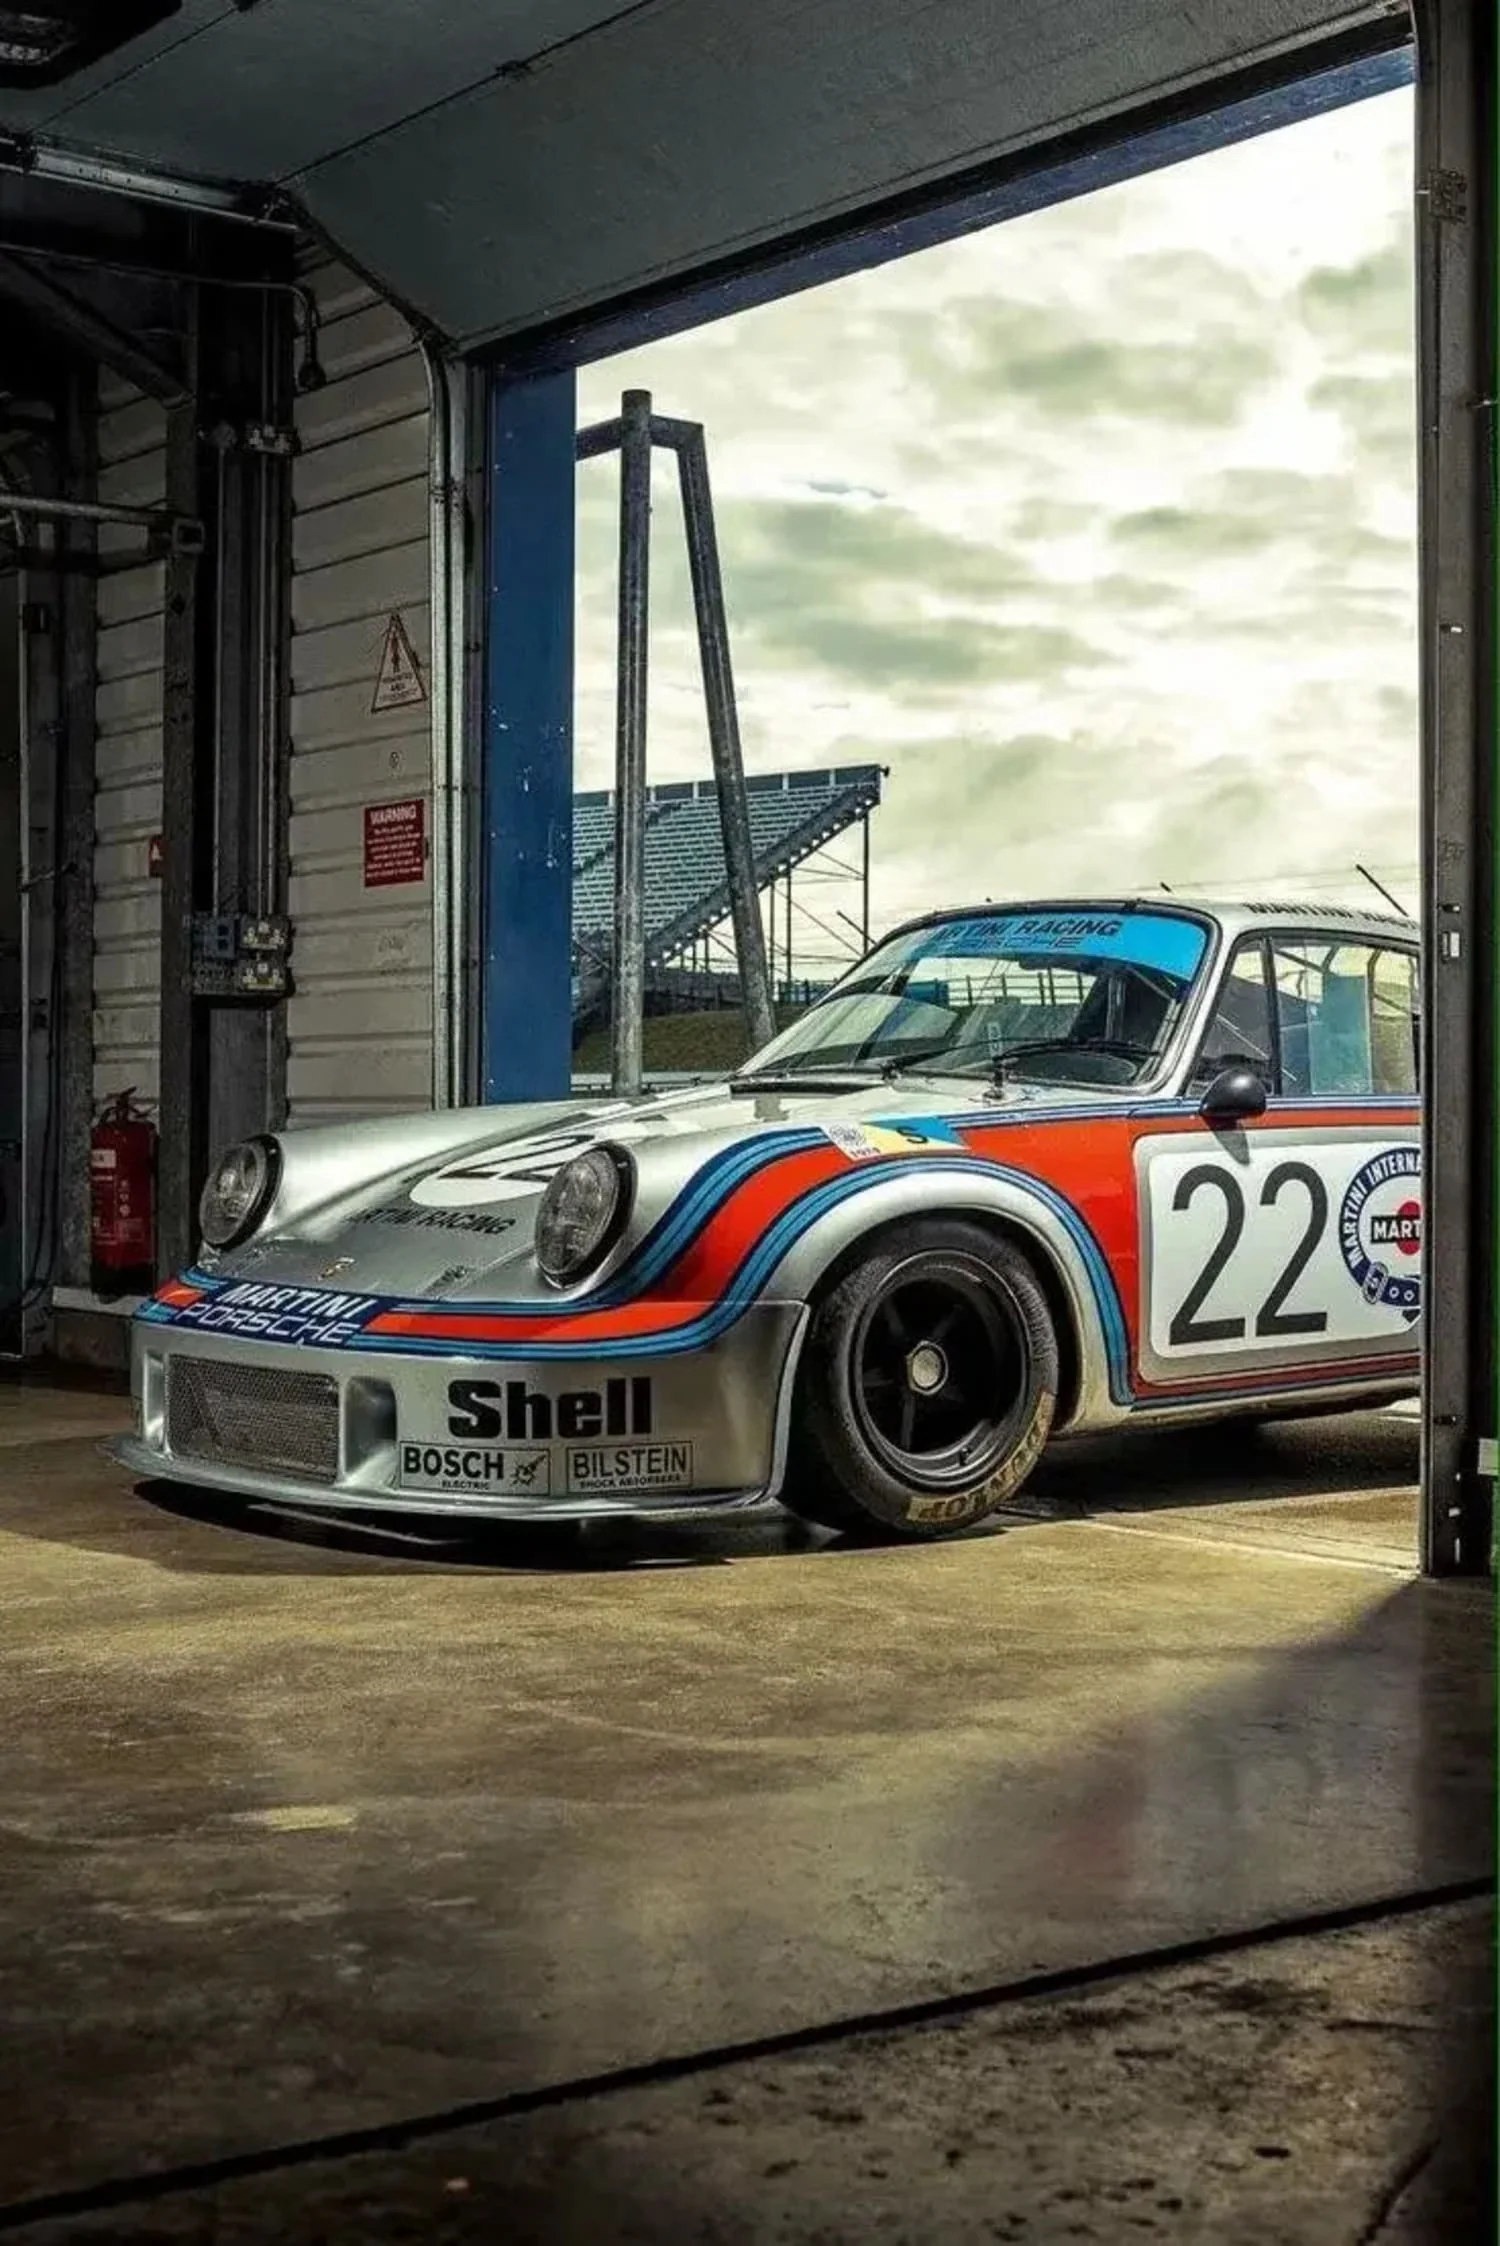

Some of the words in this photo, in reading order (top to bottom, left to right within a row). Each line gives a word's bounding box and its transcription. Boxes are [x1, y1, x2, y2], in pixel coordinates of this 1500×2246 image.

[370, 804, 417, 825] WARNING
[930, 920, 1014, 941] ARTINI
[1014, 919, 1122, 936] RACING
[416, 1209, 516, 1235] RACING
[1342, 1183, 1367, 1269] MARTINI
[1170, 1161, 1329, 1344] 22
[217, 1283, 378, 1319] MARTINI
[175, 1303, 360, 1344] PORSCHE
[448, 1377, 652, 1439] Shell
[404, 1446, 504, 1480] BOSCH
[574, 1447, 687, 1479] BILSTEIN
[441, 1480, 491, 1491] ELECTRIC
[580, 1479, 616, 1489] SHOCK
